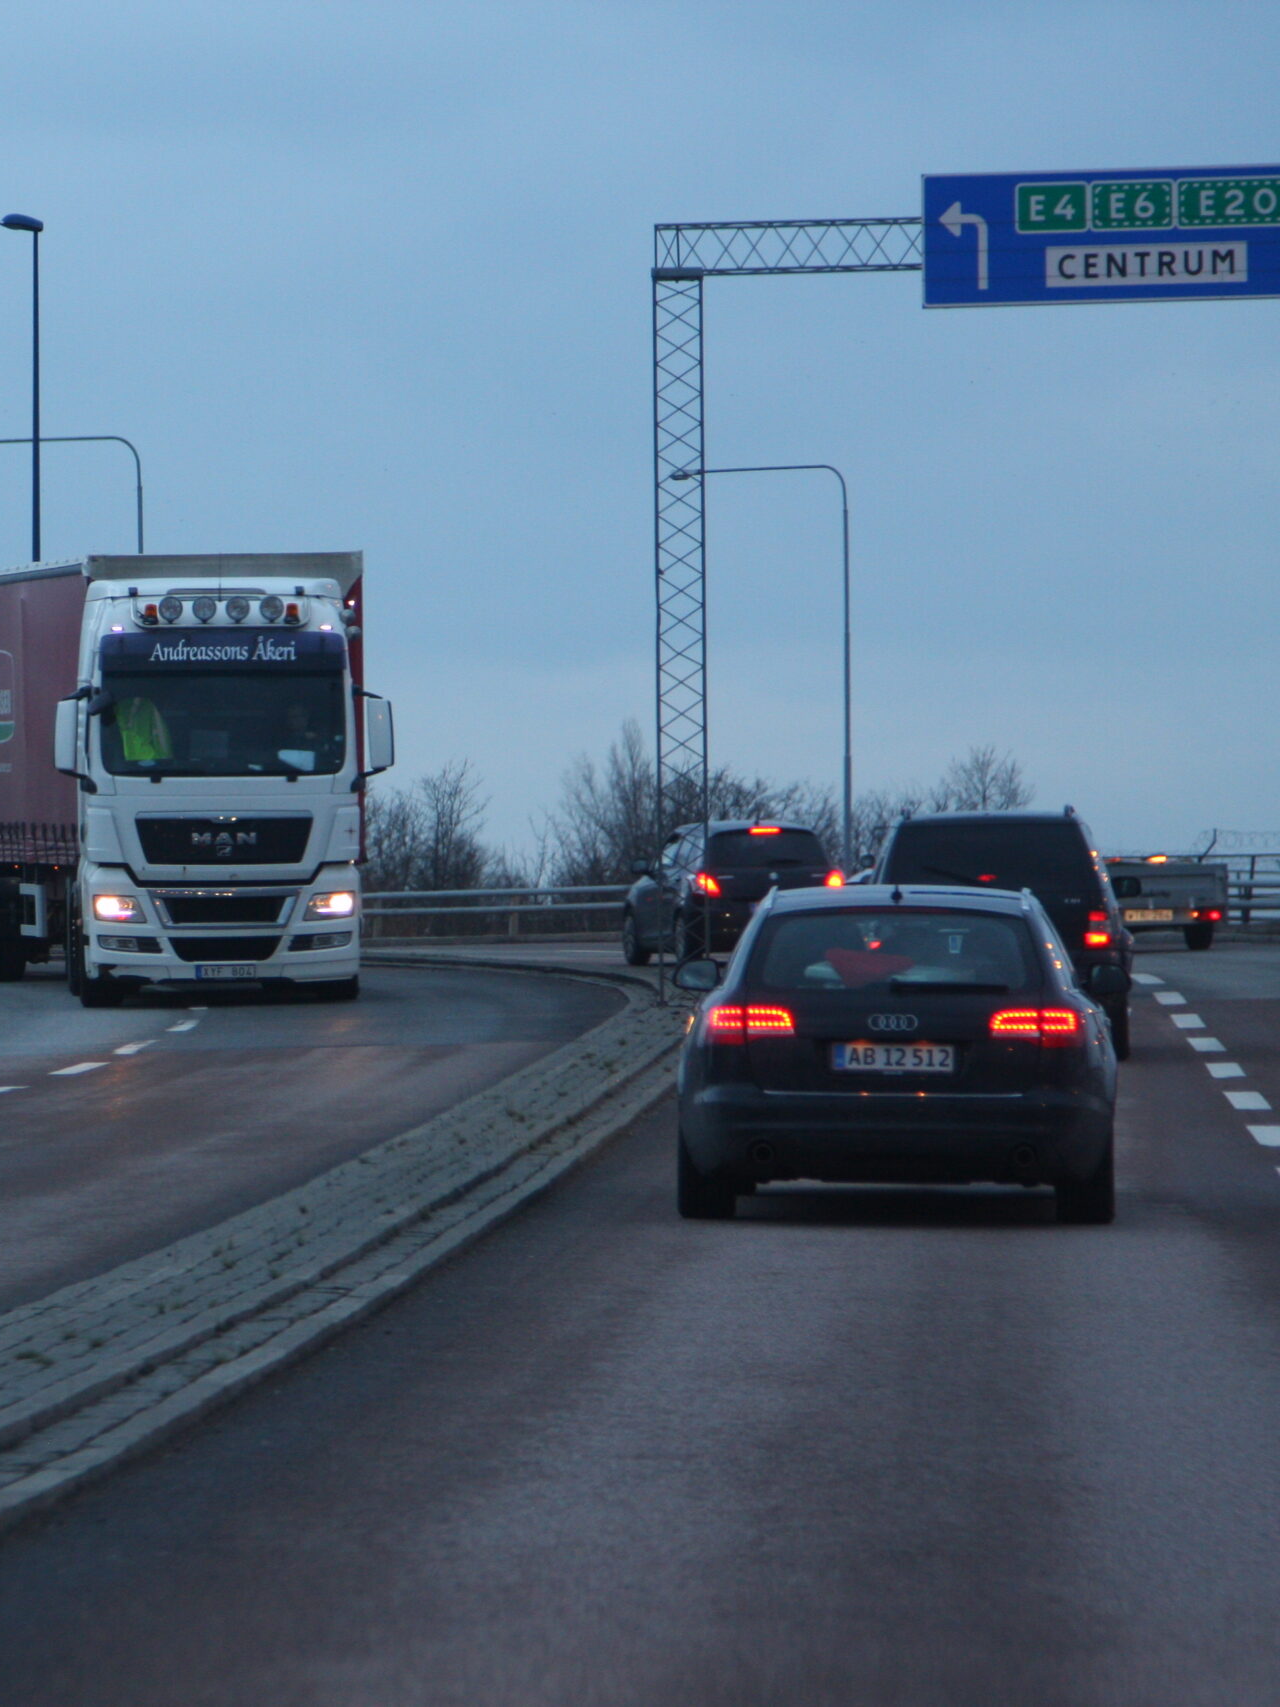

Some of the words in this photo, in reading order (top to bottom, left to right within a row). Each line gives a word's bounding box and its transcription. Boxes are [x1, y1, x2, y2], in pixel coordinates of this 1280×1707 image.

[1029, 194, 1076, 221] E4
[1110, 193, 1155, 219] E6
[1199, 188, 1278, 217] E20
[1058, 250, 1236, 280] CENTRUM
[148, 639, 248, 662] Andreassons
[252, 636, 296, 661] Åkeri
[191, 832, 257, 845] MAN
[848, 1047, 876, 1066] AB
[883, 1048, 906, 1067] 12
[911, 1048, 950, 1067] 512
